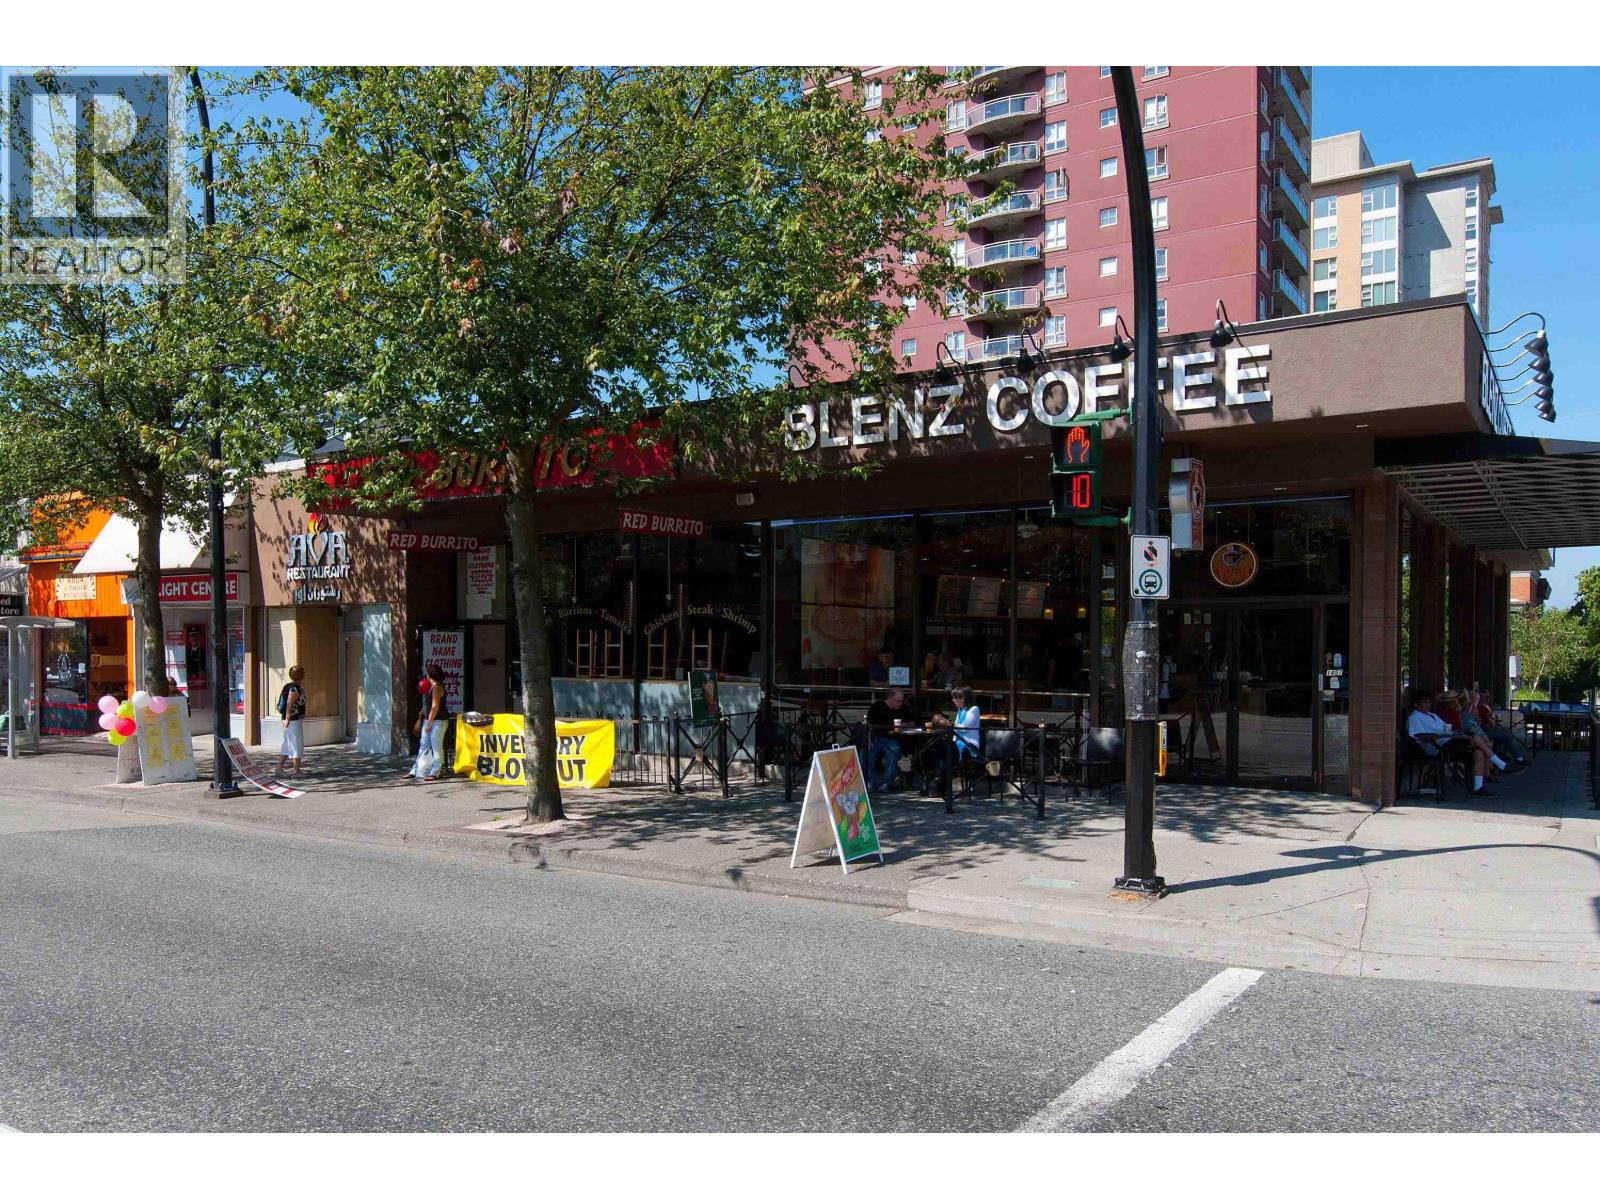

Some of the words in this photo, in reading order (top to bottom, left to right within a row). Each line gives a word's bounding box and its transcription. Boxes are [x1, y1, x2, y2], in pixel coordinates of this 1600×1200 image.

[784, 383, 965, 451] BLENZ
[1072, 474, 1091, 508] 10
[622, 512, 648, 529] RED
[651, 515, 704, 535] BURRITO
[288, 531, 350, 567] AVA
[390, 533, 417, 548] RED
[421, 534, 478, 550] BURRITO
[287, 565, 351, 580] RESTAURANT
[158, 582, 188, 596] IGHT
[687, 604, 714, 616] Steak
[721, 607, 756, 634] Shrimp
[430, 633, 458, 645] BRAND
[432, 646, 456, 657] NAME
[480, 733, 586, 755] INVERY
[476, 755, 587, 782] BLOUT
